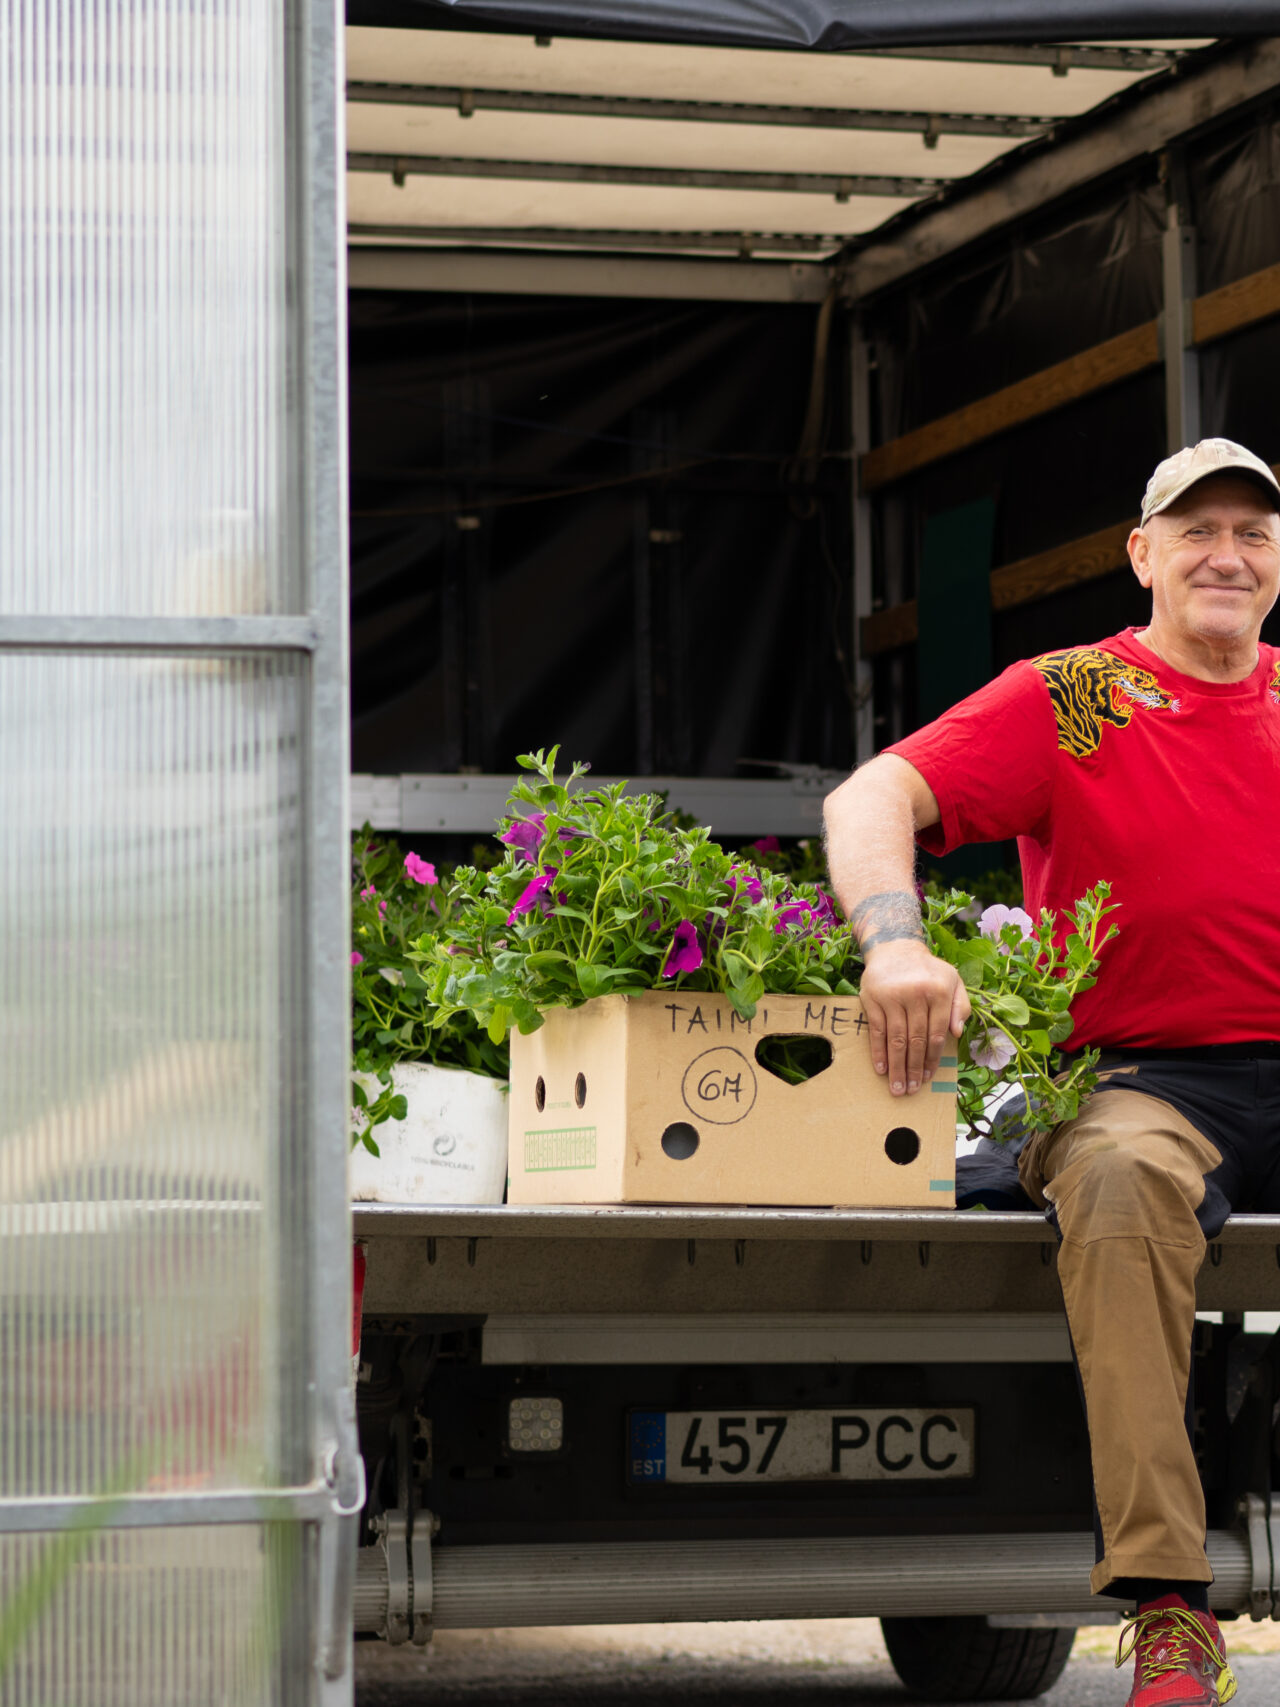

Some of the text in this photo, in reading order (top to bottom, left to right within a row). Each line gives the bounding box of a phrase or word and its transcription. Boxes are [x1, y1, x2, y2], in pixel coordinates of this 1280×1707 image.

[664, 1003, 768, 1034] TAIMI
[681, 1415, 958, 1475] 457 PCC
[632, 1459, 664, 1476] EST
